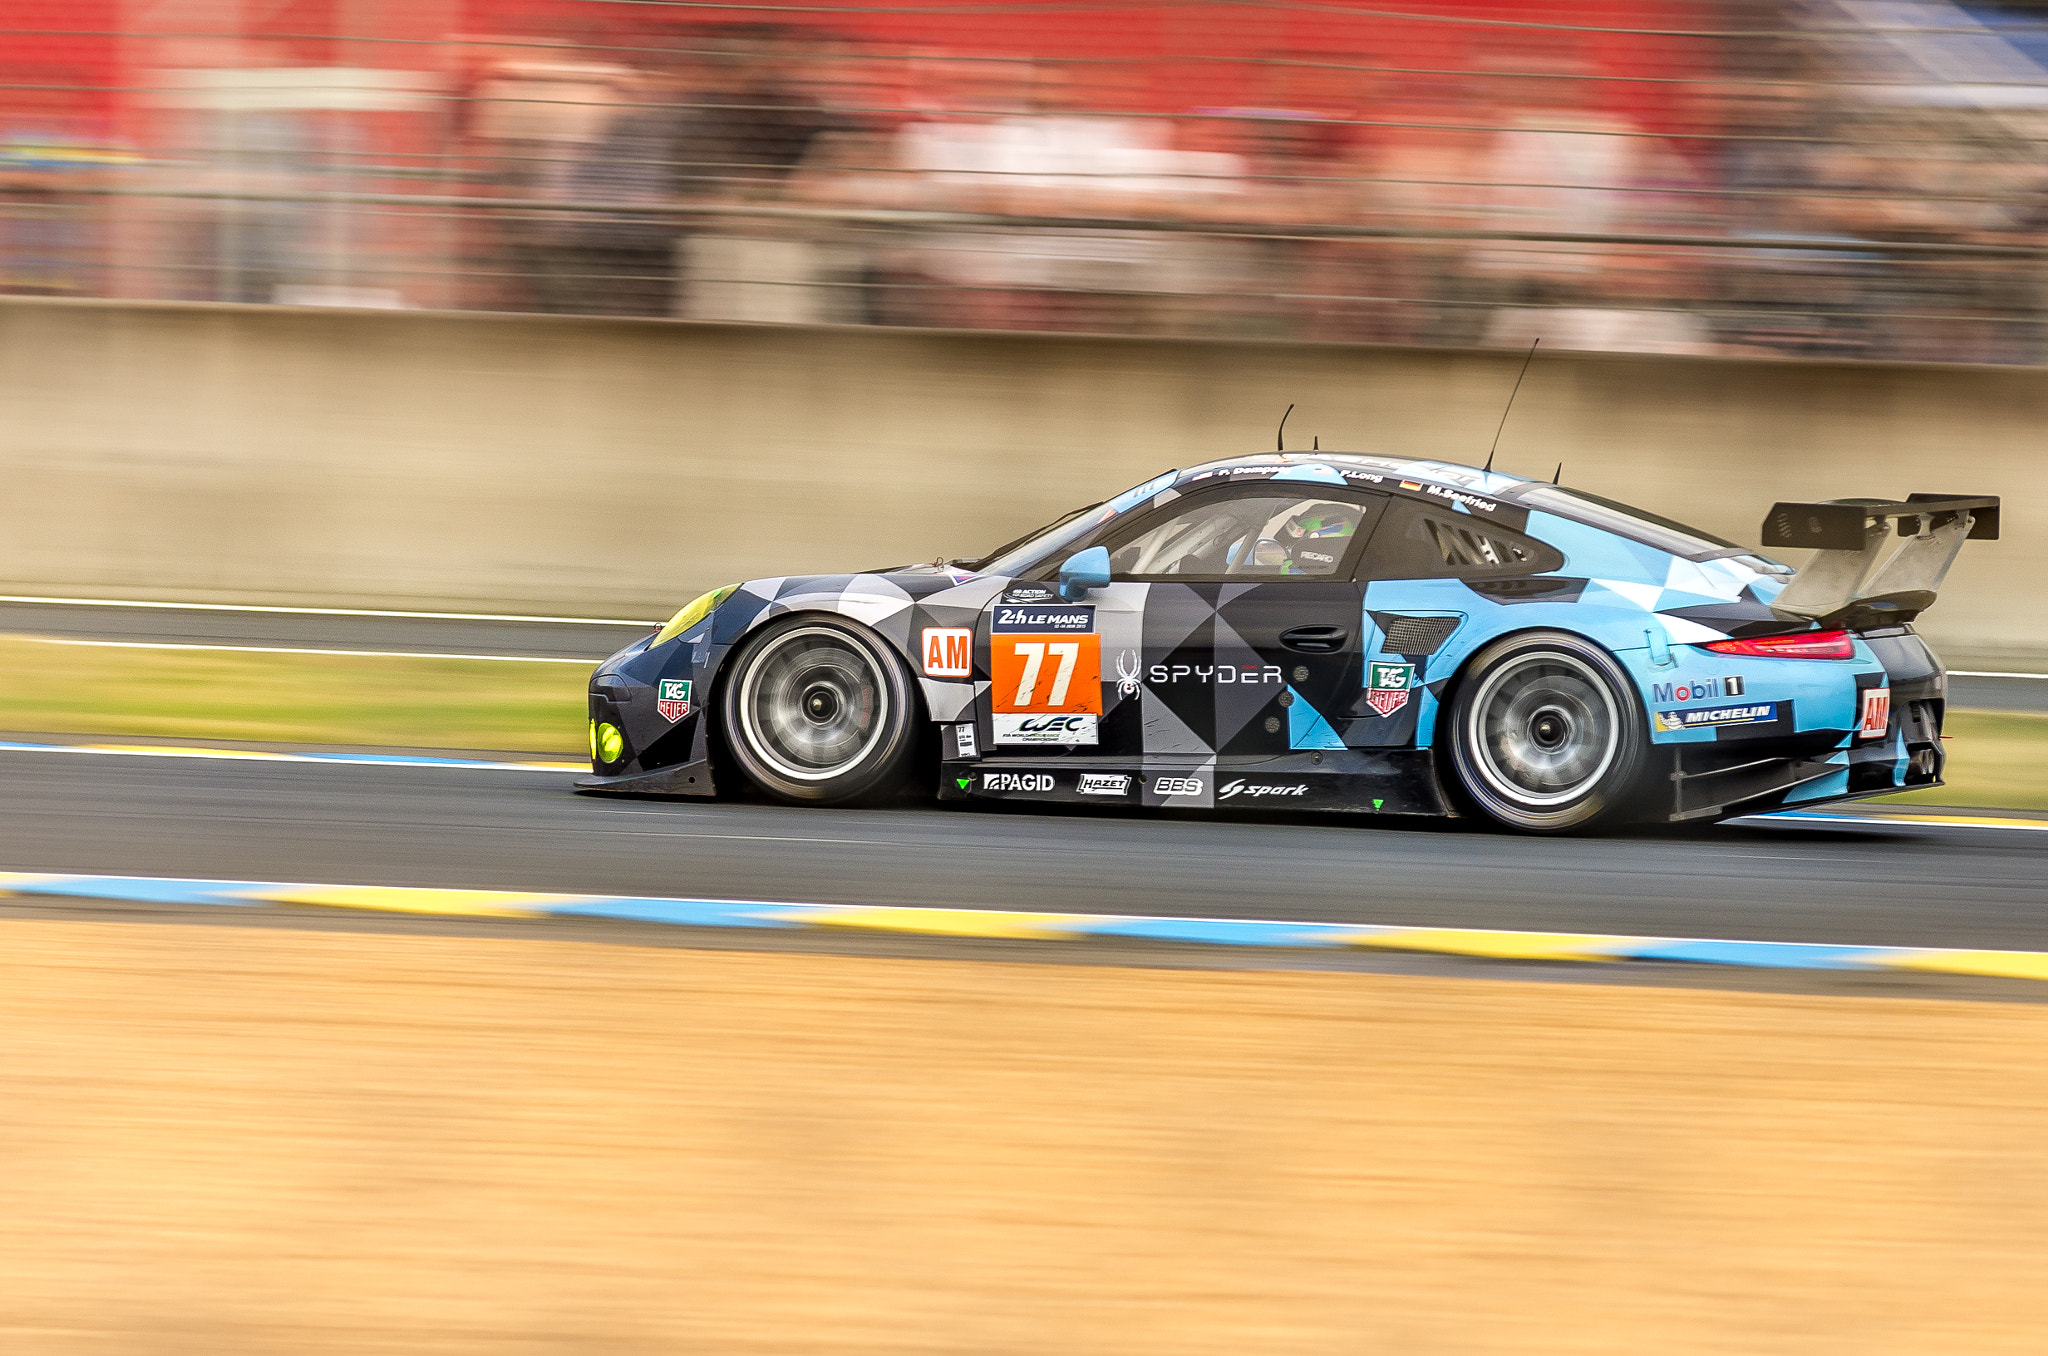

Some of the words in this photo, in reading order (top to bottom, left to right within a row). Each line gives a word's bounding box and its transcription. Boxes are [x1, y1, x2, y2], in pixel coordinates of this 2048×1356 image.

[1427, 485, 1496, 512] M.Seefried
[1027, 614, 1047, 625] LE
[1046, 614, 1089, 625] MANS
[928, 635, 968, 669] AM
[1013, 643, 1080, 706] 77
[1149, 665, 1283, 684] SPYDER
[1376, 667, 1407, 688] TAG
[664, 682, 686, 700] TAG
[1653, 679, 1719, 703] Mobil
[1727, 677, 1738, 695] 1
[660, 701, 688, 720] HEUER
[1685, 705, 1770, 722] MICHELIN
[1863, 697, 1889, 731] AM
[1019, 716, 1083, 731] WEC
[1000, 773, 1055, 792] PAGID
[1084, 779, 1125, 789] HAZET
[1156, 779, 1199, 793] BBS
[1243, 784, 1309, 797] spark
